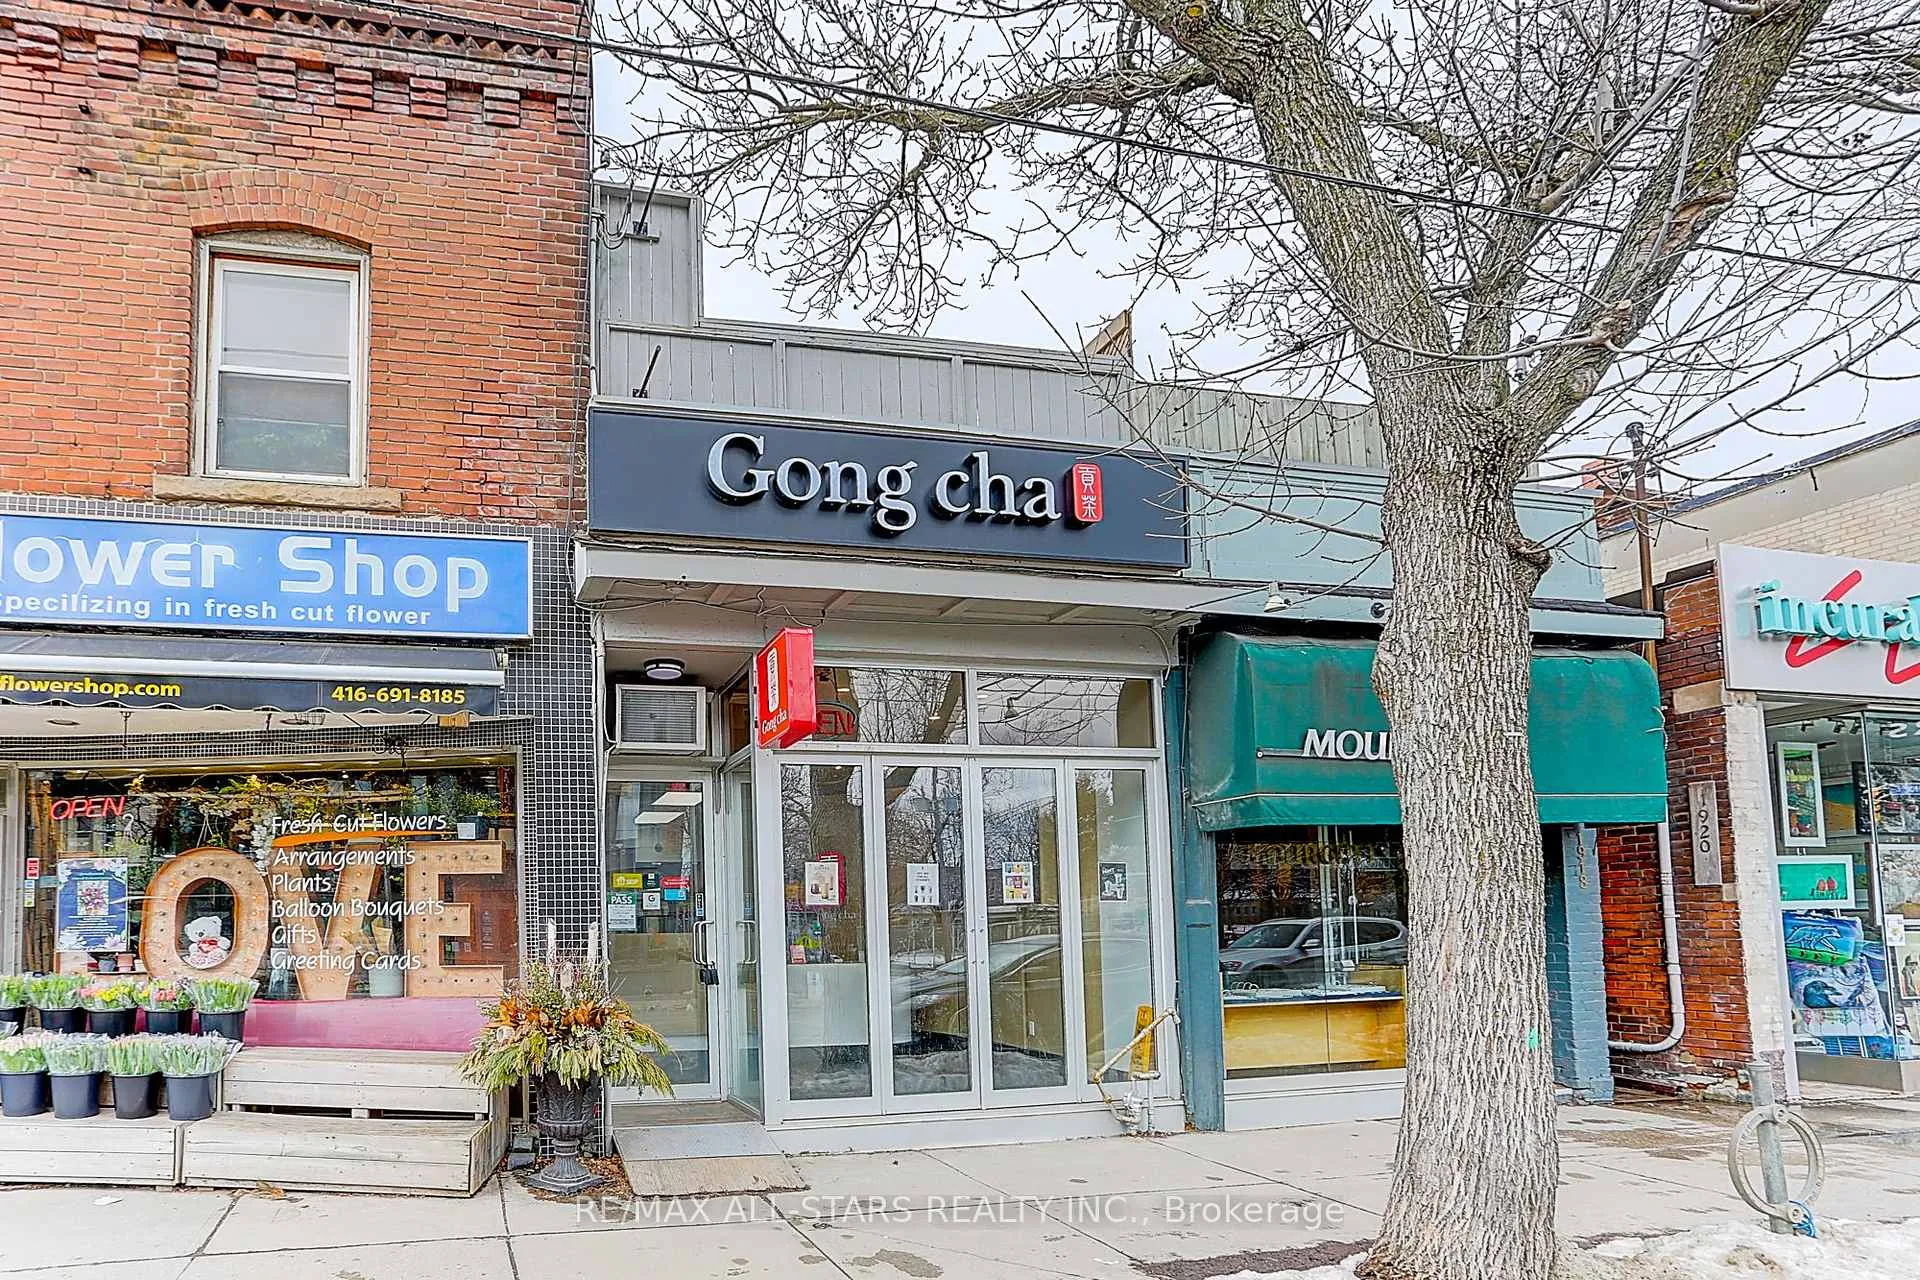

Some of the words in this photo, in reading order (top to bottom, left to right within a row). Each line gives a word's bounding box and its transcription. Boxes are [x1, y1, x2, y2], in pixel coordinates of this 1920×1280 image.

[707, 432, 918, 531] Gong
[935, 450, 1063, 520] cha
[1077, 465, 1098, 519] 貢茶
[278, 534, 489, 613] Shop
[0, 593, 150, 618] pecilizing
[164, 597, 190, 616] in
[204, 598, 277, 620] fresh
[290, 605, 335, 622] cut
[346, 604, 431, 625] flower
[1756, 580, 1920, 643] incura
[331, 685, 465, 704] 416-691-8185
[1301, 728, 1393, 760] MOU
[50, 796, 126, 820] OPEN
[271, 813, 323, 834] Fresh
[333, 813, 365, 832] Cut
[371, 811, 446, 831] Flowers
[272, 847, 416, 871] Arrangements
[271, 872, 332, 892] Plants
[271, 898, 345, 918] Balloon
[351, 897, 445, 922] Bouquets
[610, 895, 633, 904] PASS
[271, 924, 317, 944] Gifts
[270, 949, 356, 975] Greeting
[361, 950, 422, 970] Cards
